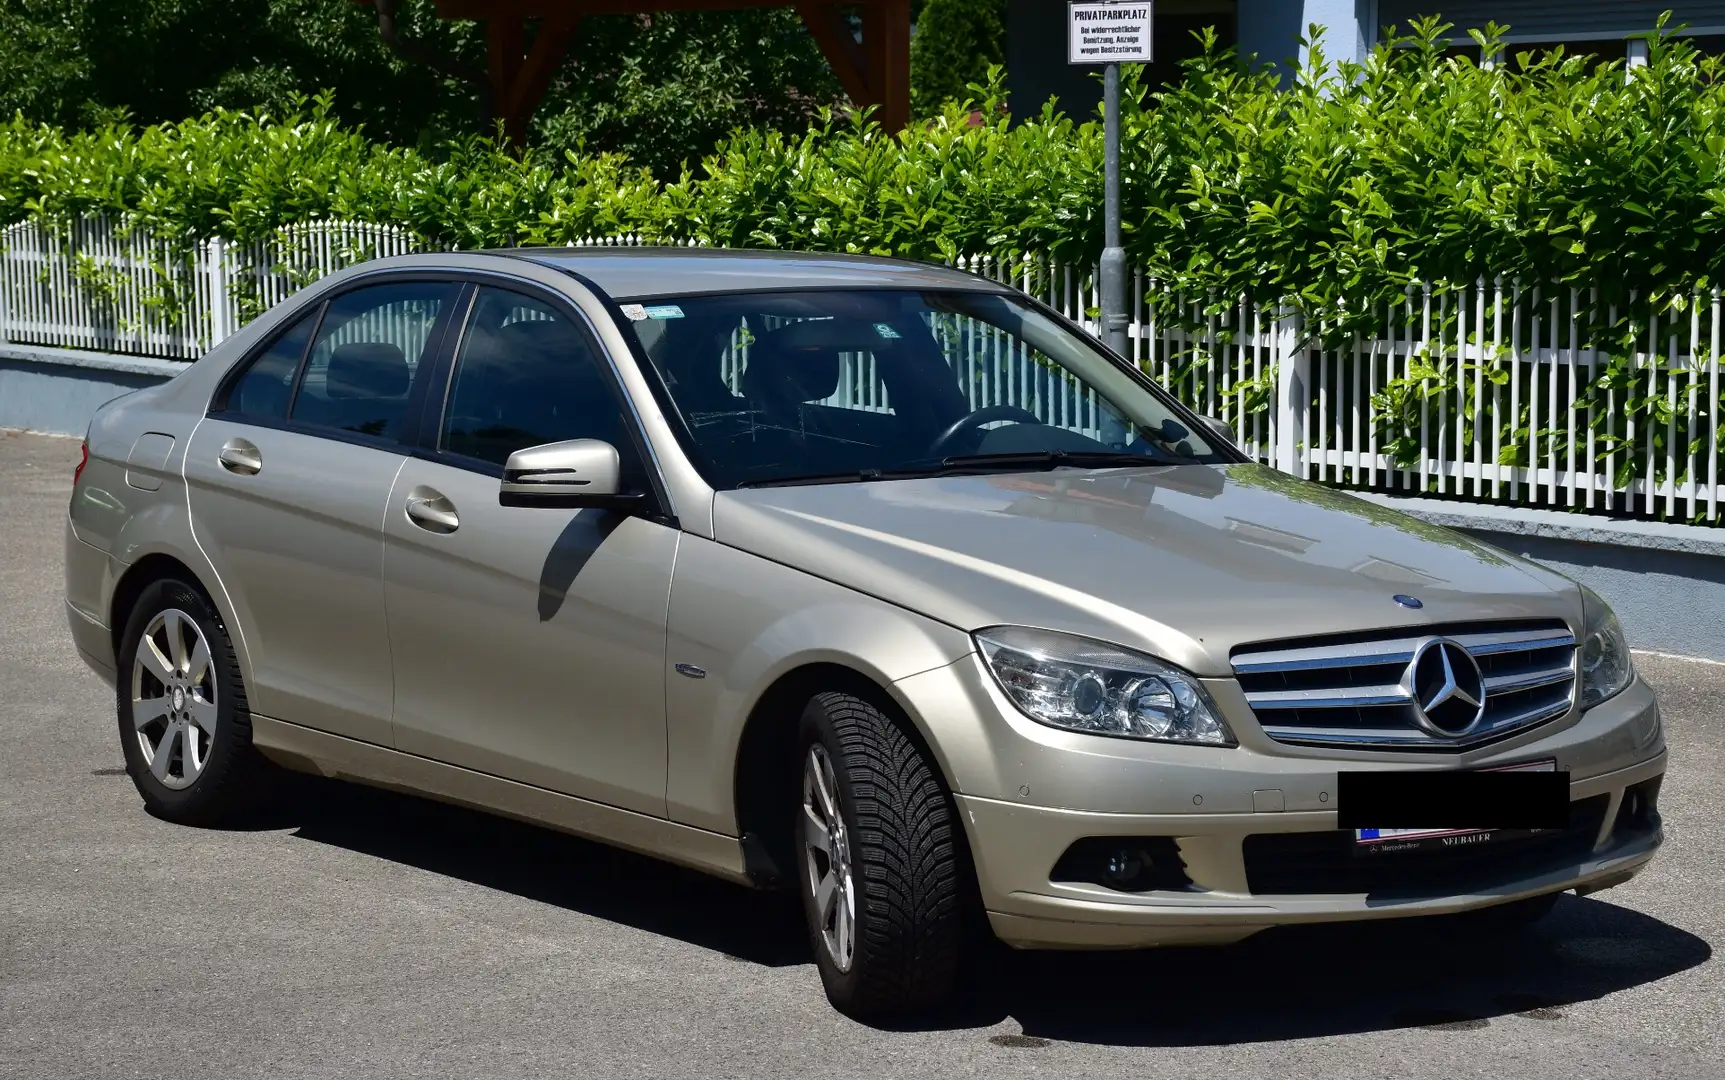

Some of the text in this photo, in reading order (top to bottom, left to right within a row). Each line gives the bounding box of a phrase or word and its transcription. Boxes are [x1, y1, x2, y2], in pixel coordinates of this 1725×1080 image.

[1074, 10, 1147, 20] PRIVATPARKPLATZ
[1091, 25, 1141, 33] widerrechtlicher
[1116, 35, 1139, 44] Anzeige
[1080, 46, 1142, 55] wegen Besitzstörung
[1441, 833, 1491, 846] NEUBAUER
